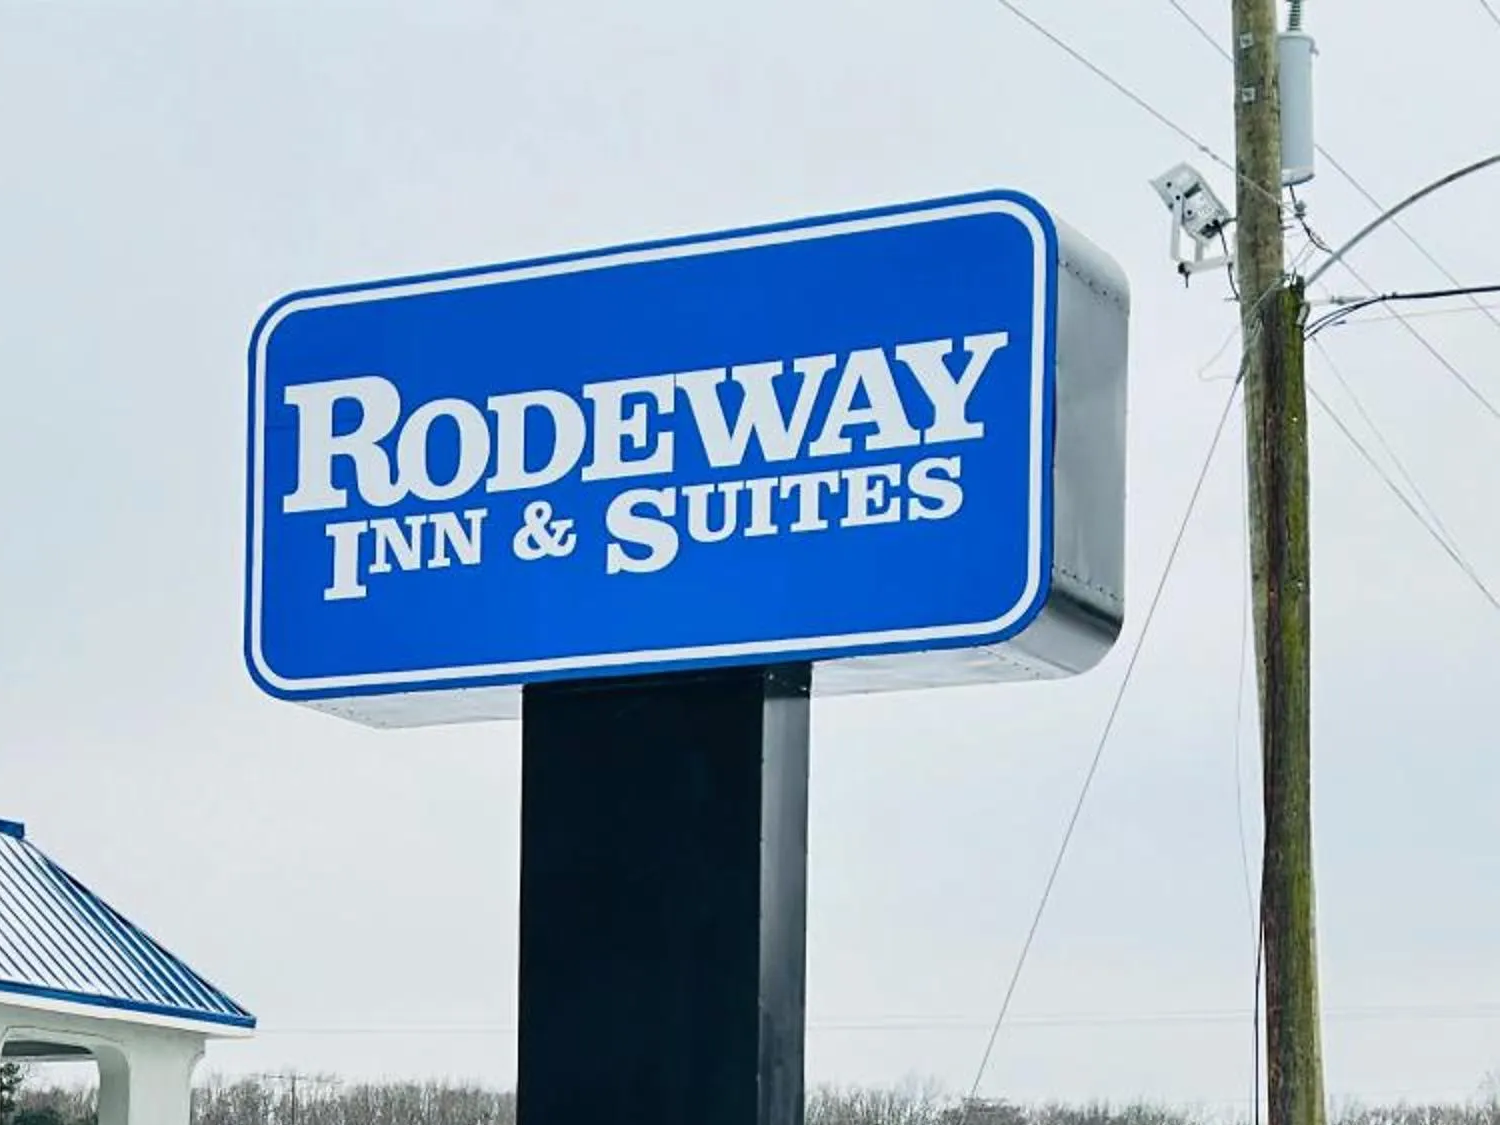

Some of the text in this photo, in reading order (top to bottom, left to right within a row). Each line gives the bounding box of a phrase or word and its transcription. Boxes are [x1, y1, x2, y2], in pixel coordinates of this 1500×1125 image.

[283, 331, 1008, 513] RODEWAY
[324, 457, 963, 600] INN & SUITES
